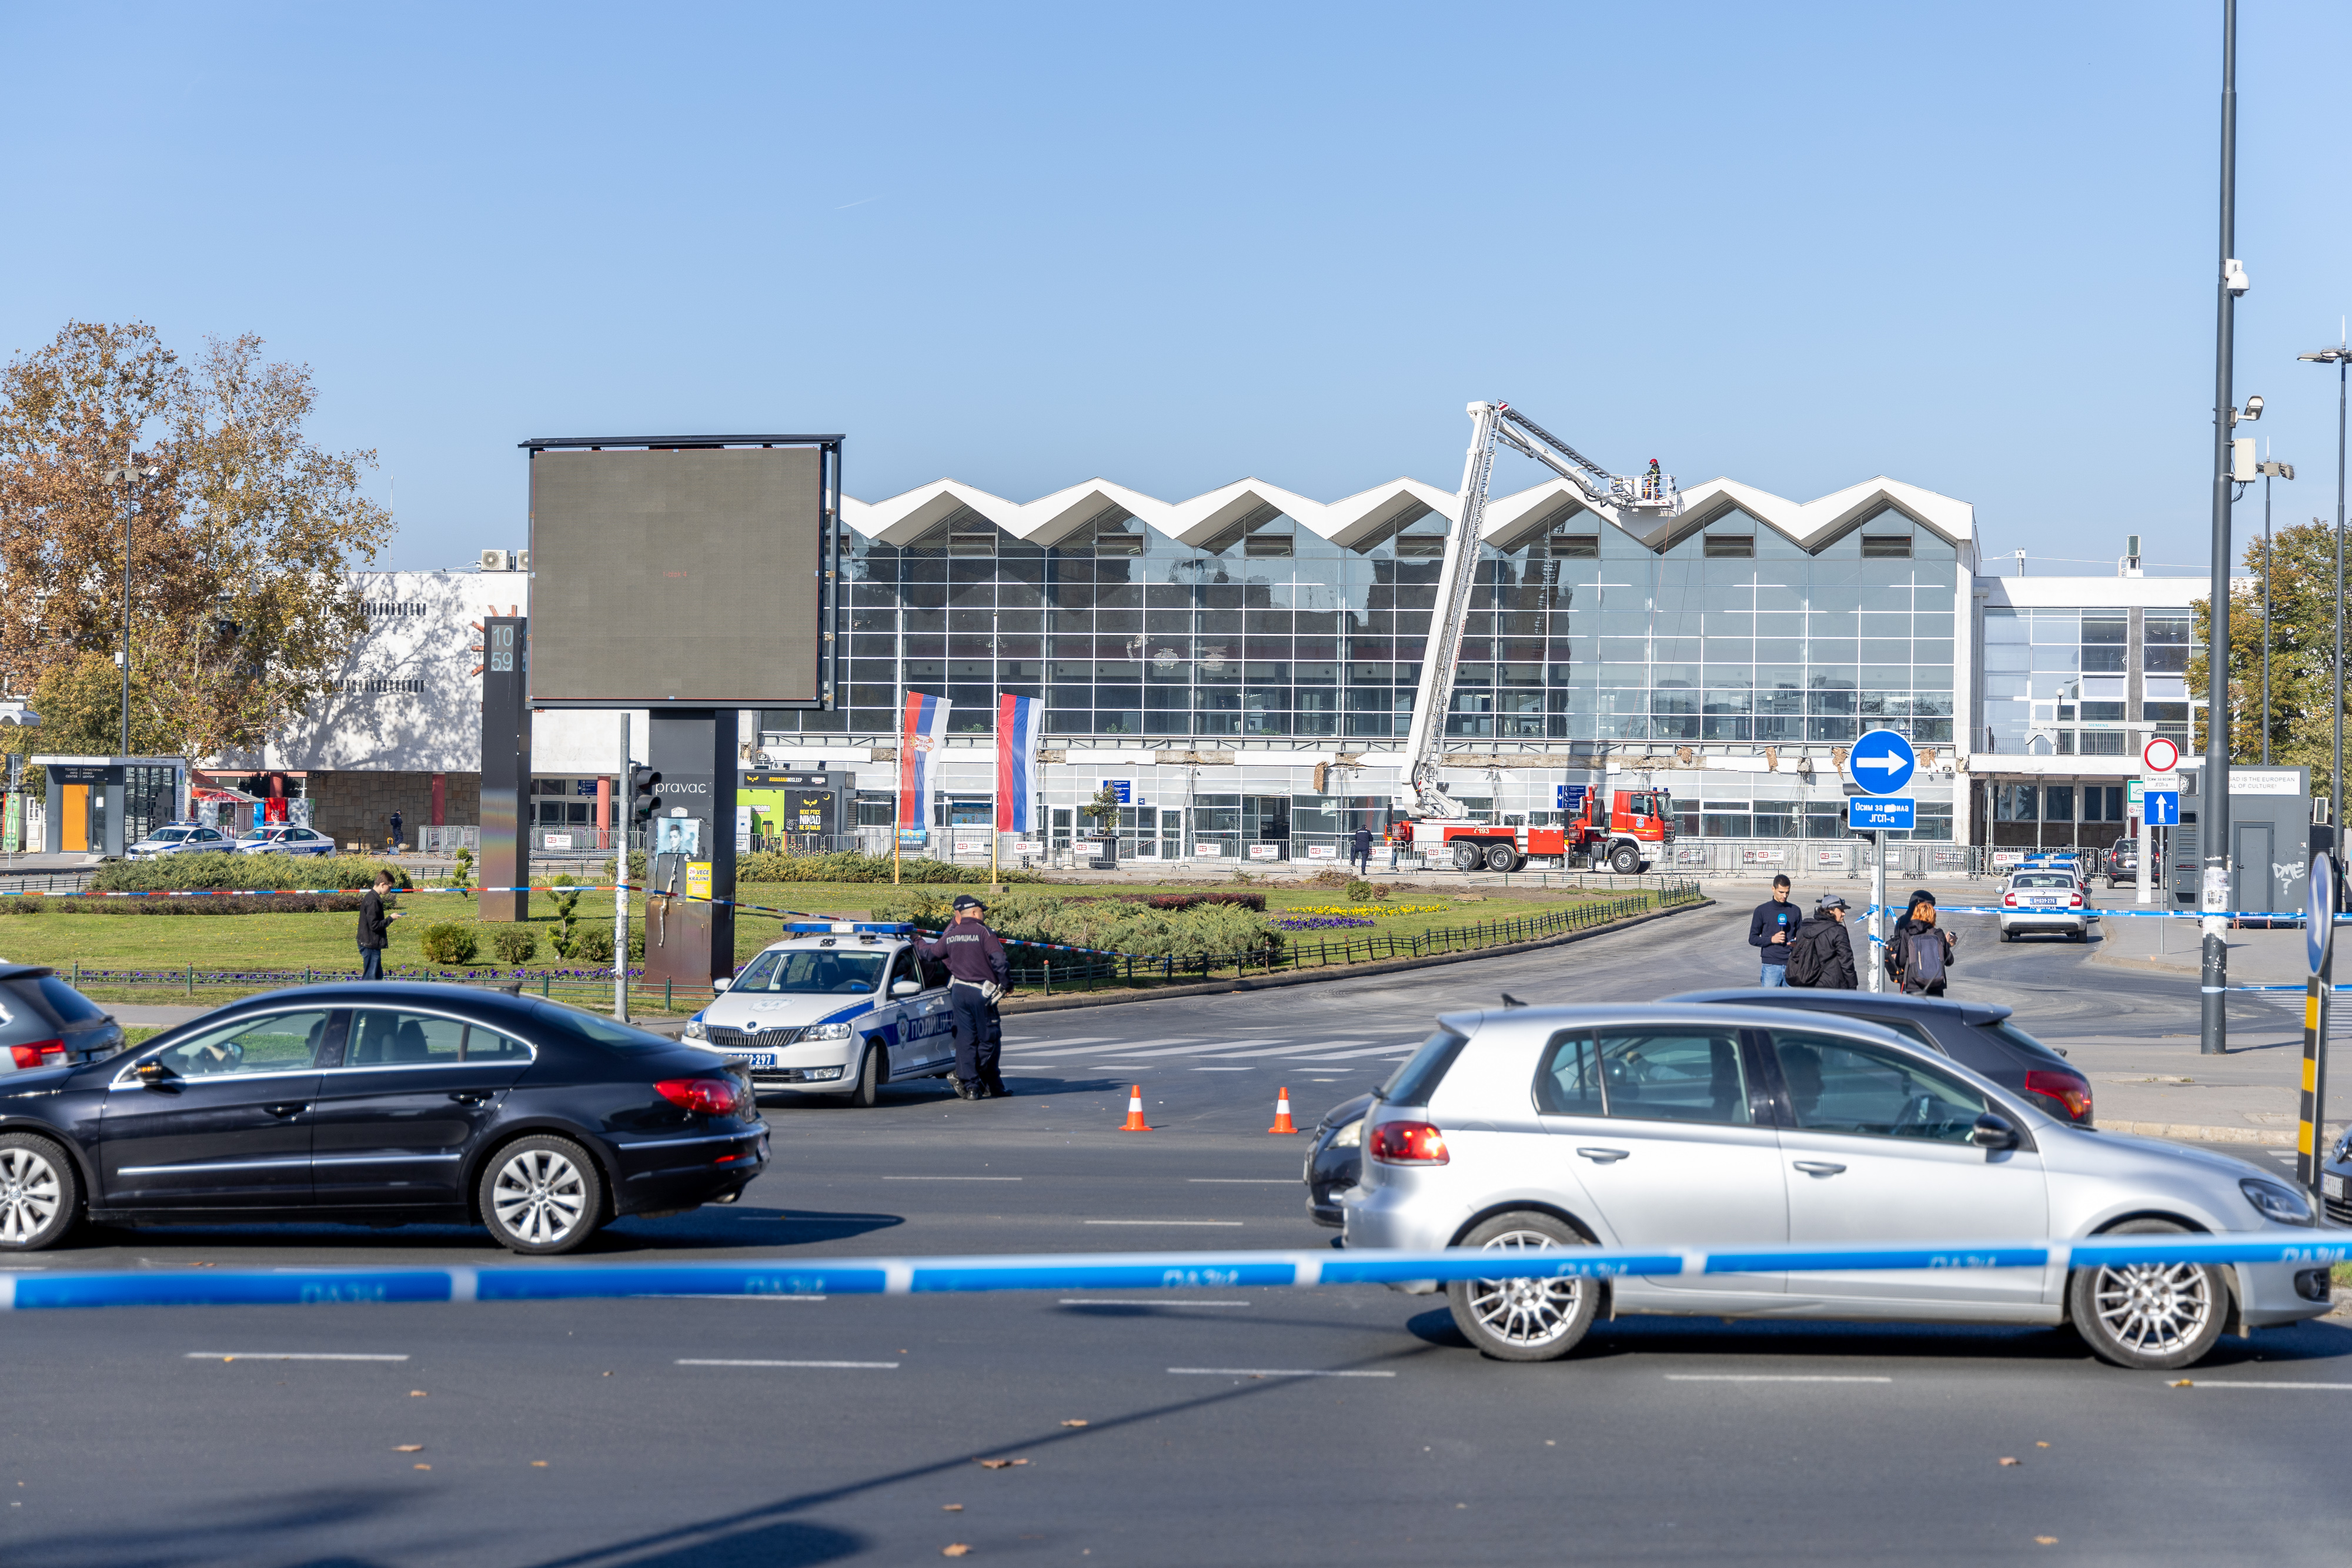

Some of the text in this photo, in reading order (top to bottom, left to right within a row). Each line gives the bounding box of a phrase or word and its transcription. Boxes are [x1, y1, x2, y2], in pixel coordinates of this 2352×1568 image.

[493, 627, 514, 647] 10
[491, 651, 513, 671] 59
[656, 783, 707, 795] pravac
[1855, 802, 1873, 811] Осим
[800, 815, 821, 825] NIKAD
[1869, 814, 1895, 823] ЈГСП-а
[947, 935, 980, 944] ПОЛИЦИЈА
[911, 1013, 953, 1039] ПОЛИЦИЈ
